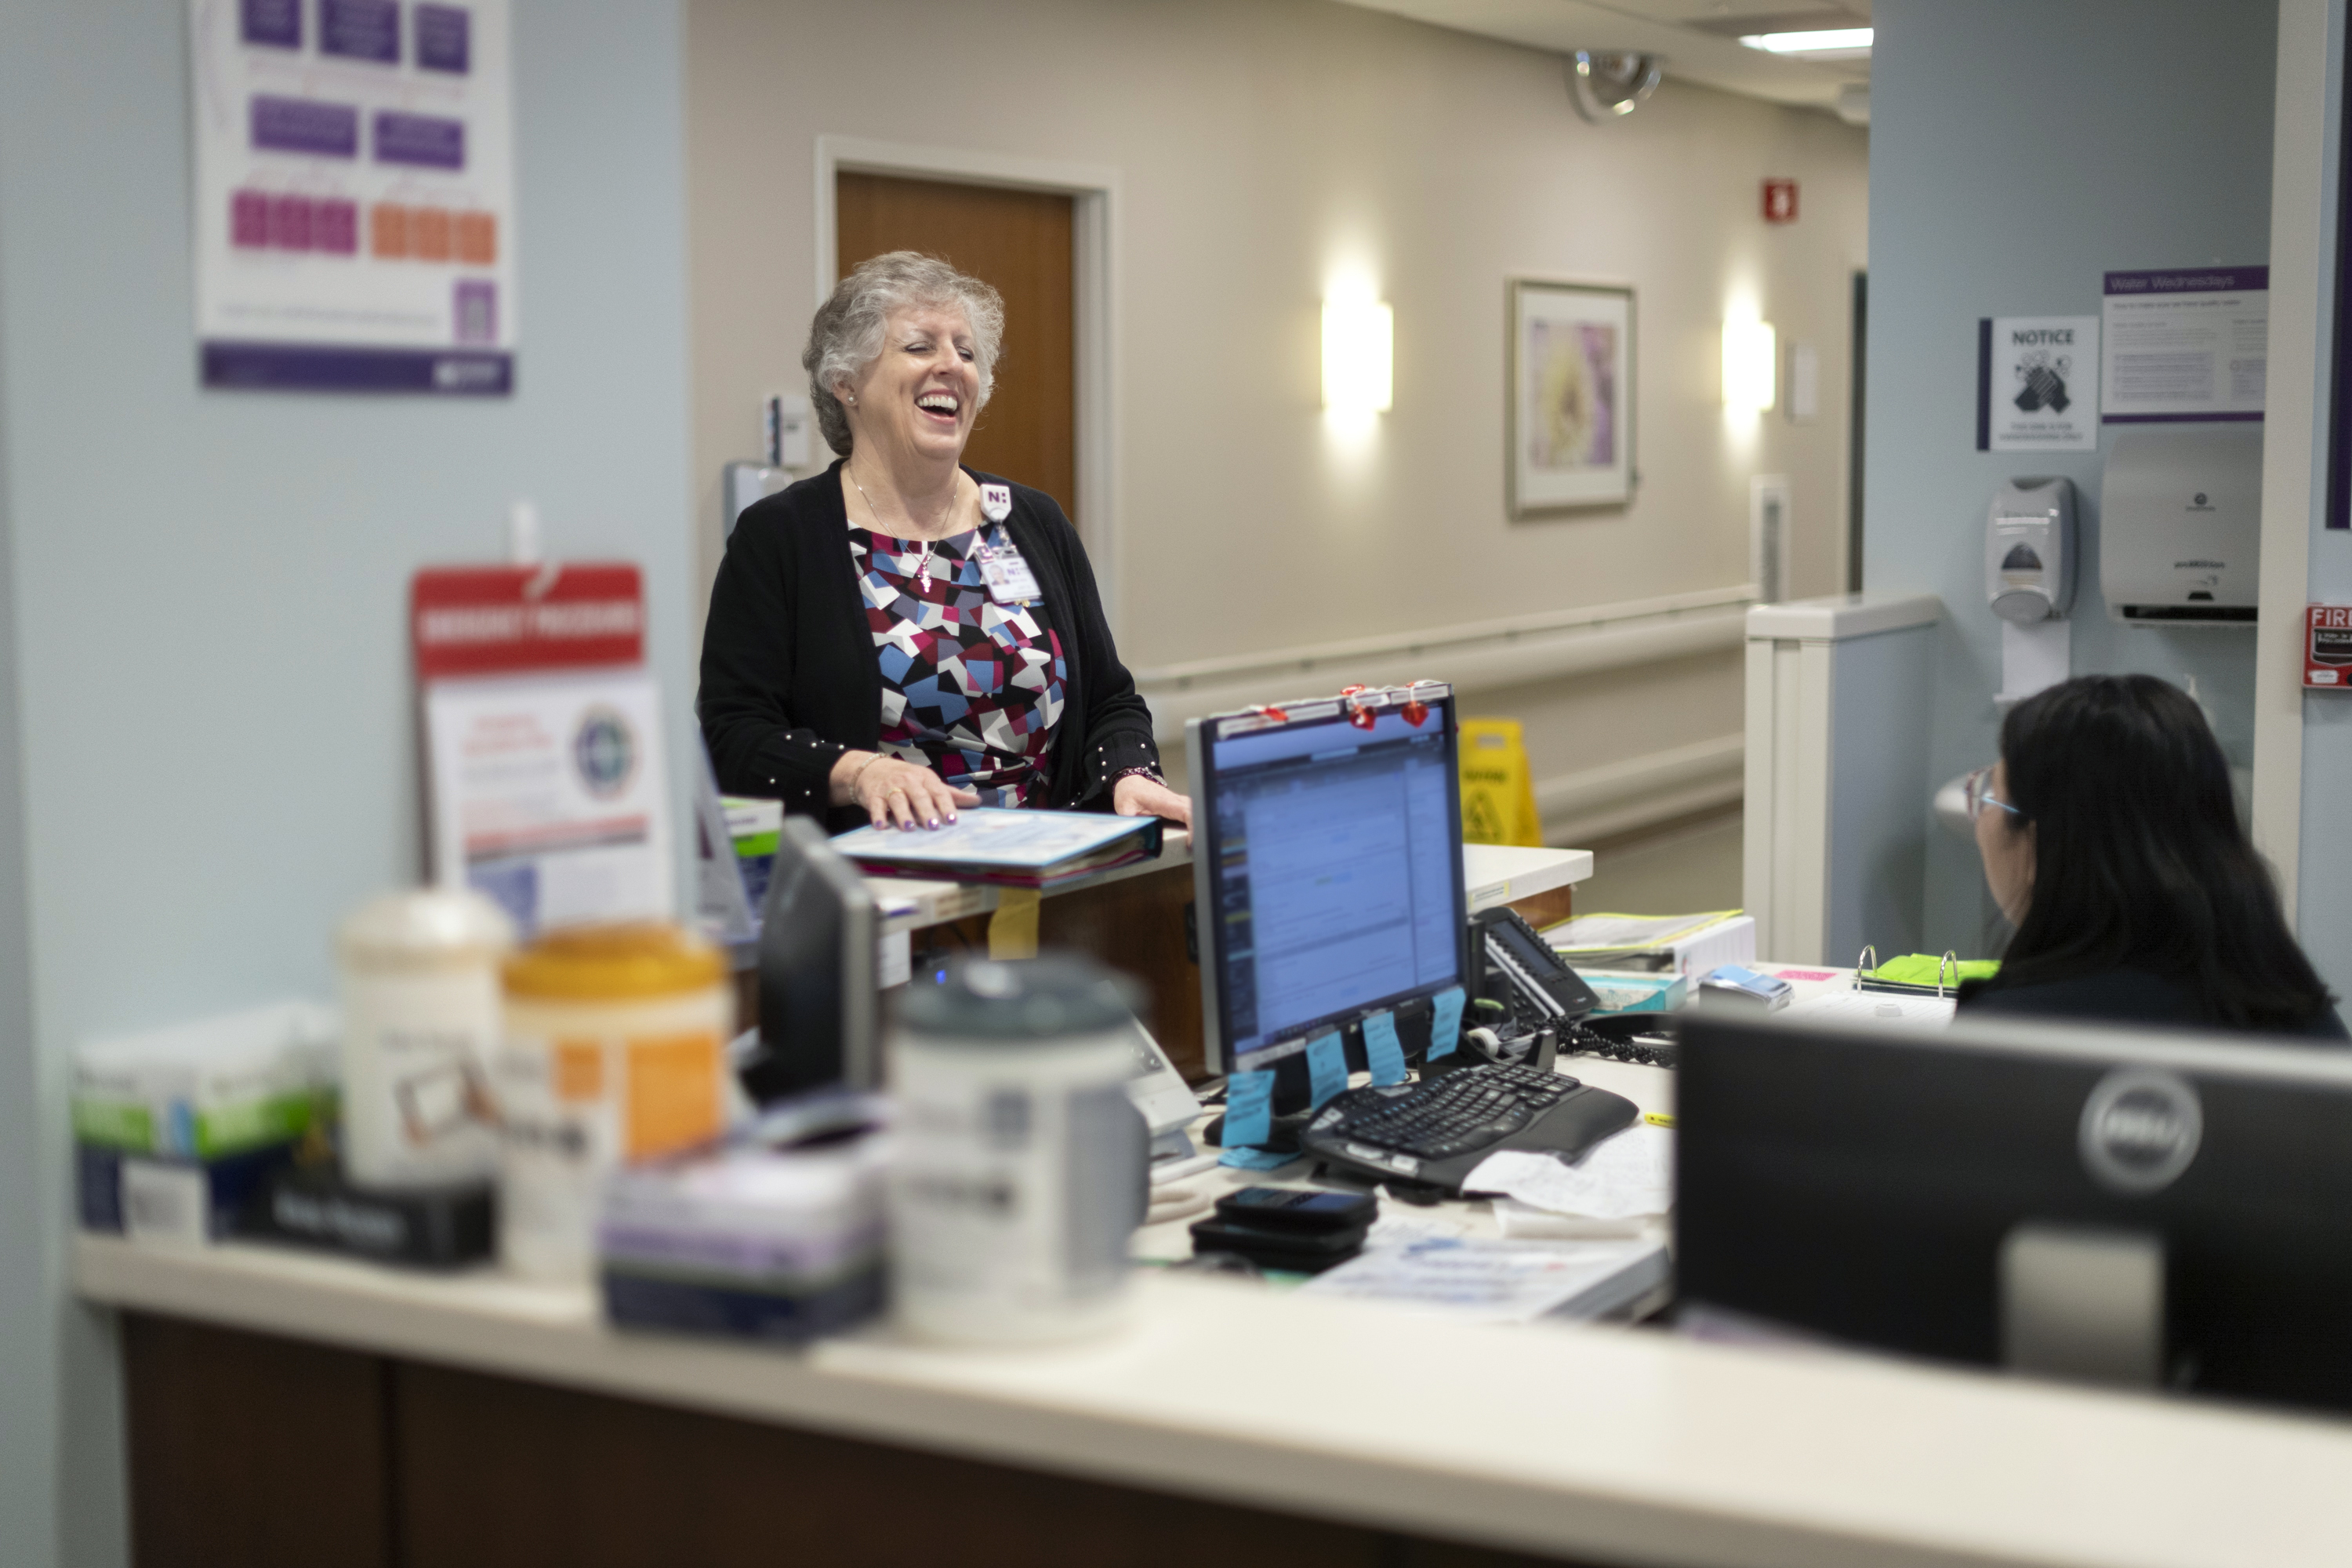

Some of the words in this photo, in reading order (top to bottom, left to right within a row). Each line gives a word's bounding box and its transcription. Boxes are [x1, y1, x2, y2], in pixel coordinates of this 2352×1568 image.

[2111, 278, 2148, 291] Water
[2151, 275, 2234, 290] Wednesdays
[2013, 328, 2074, 346] NOTICE
